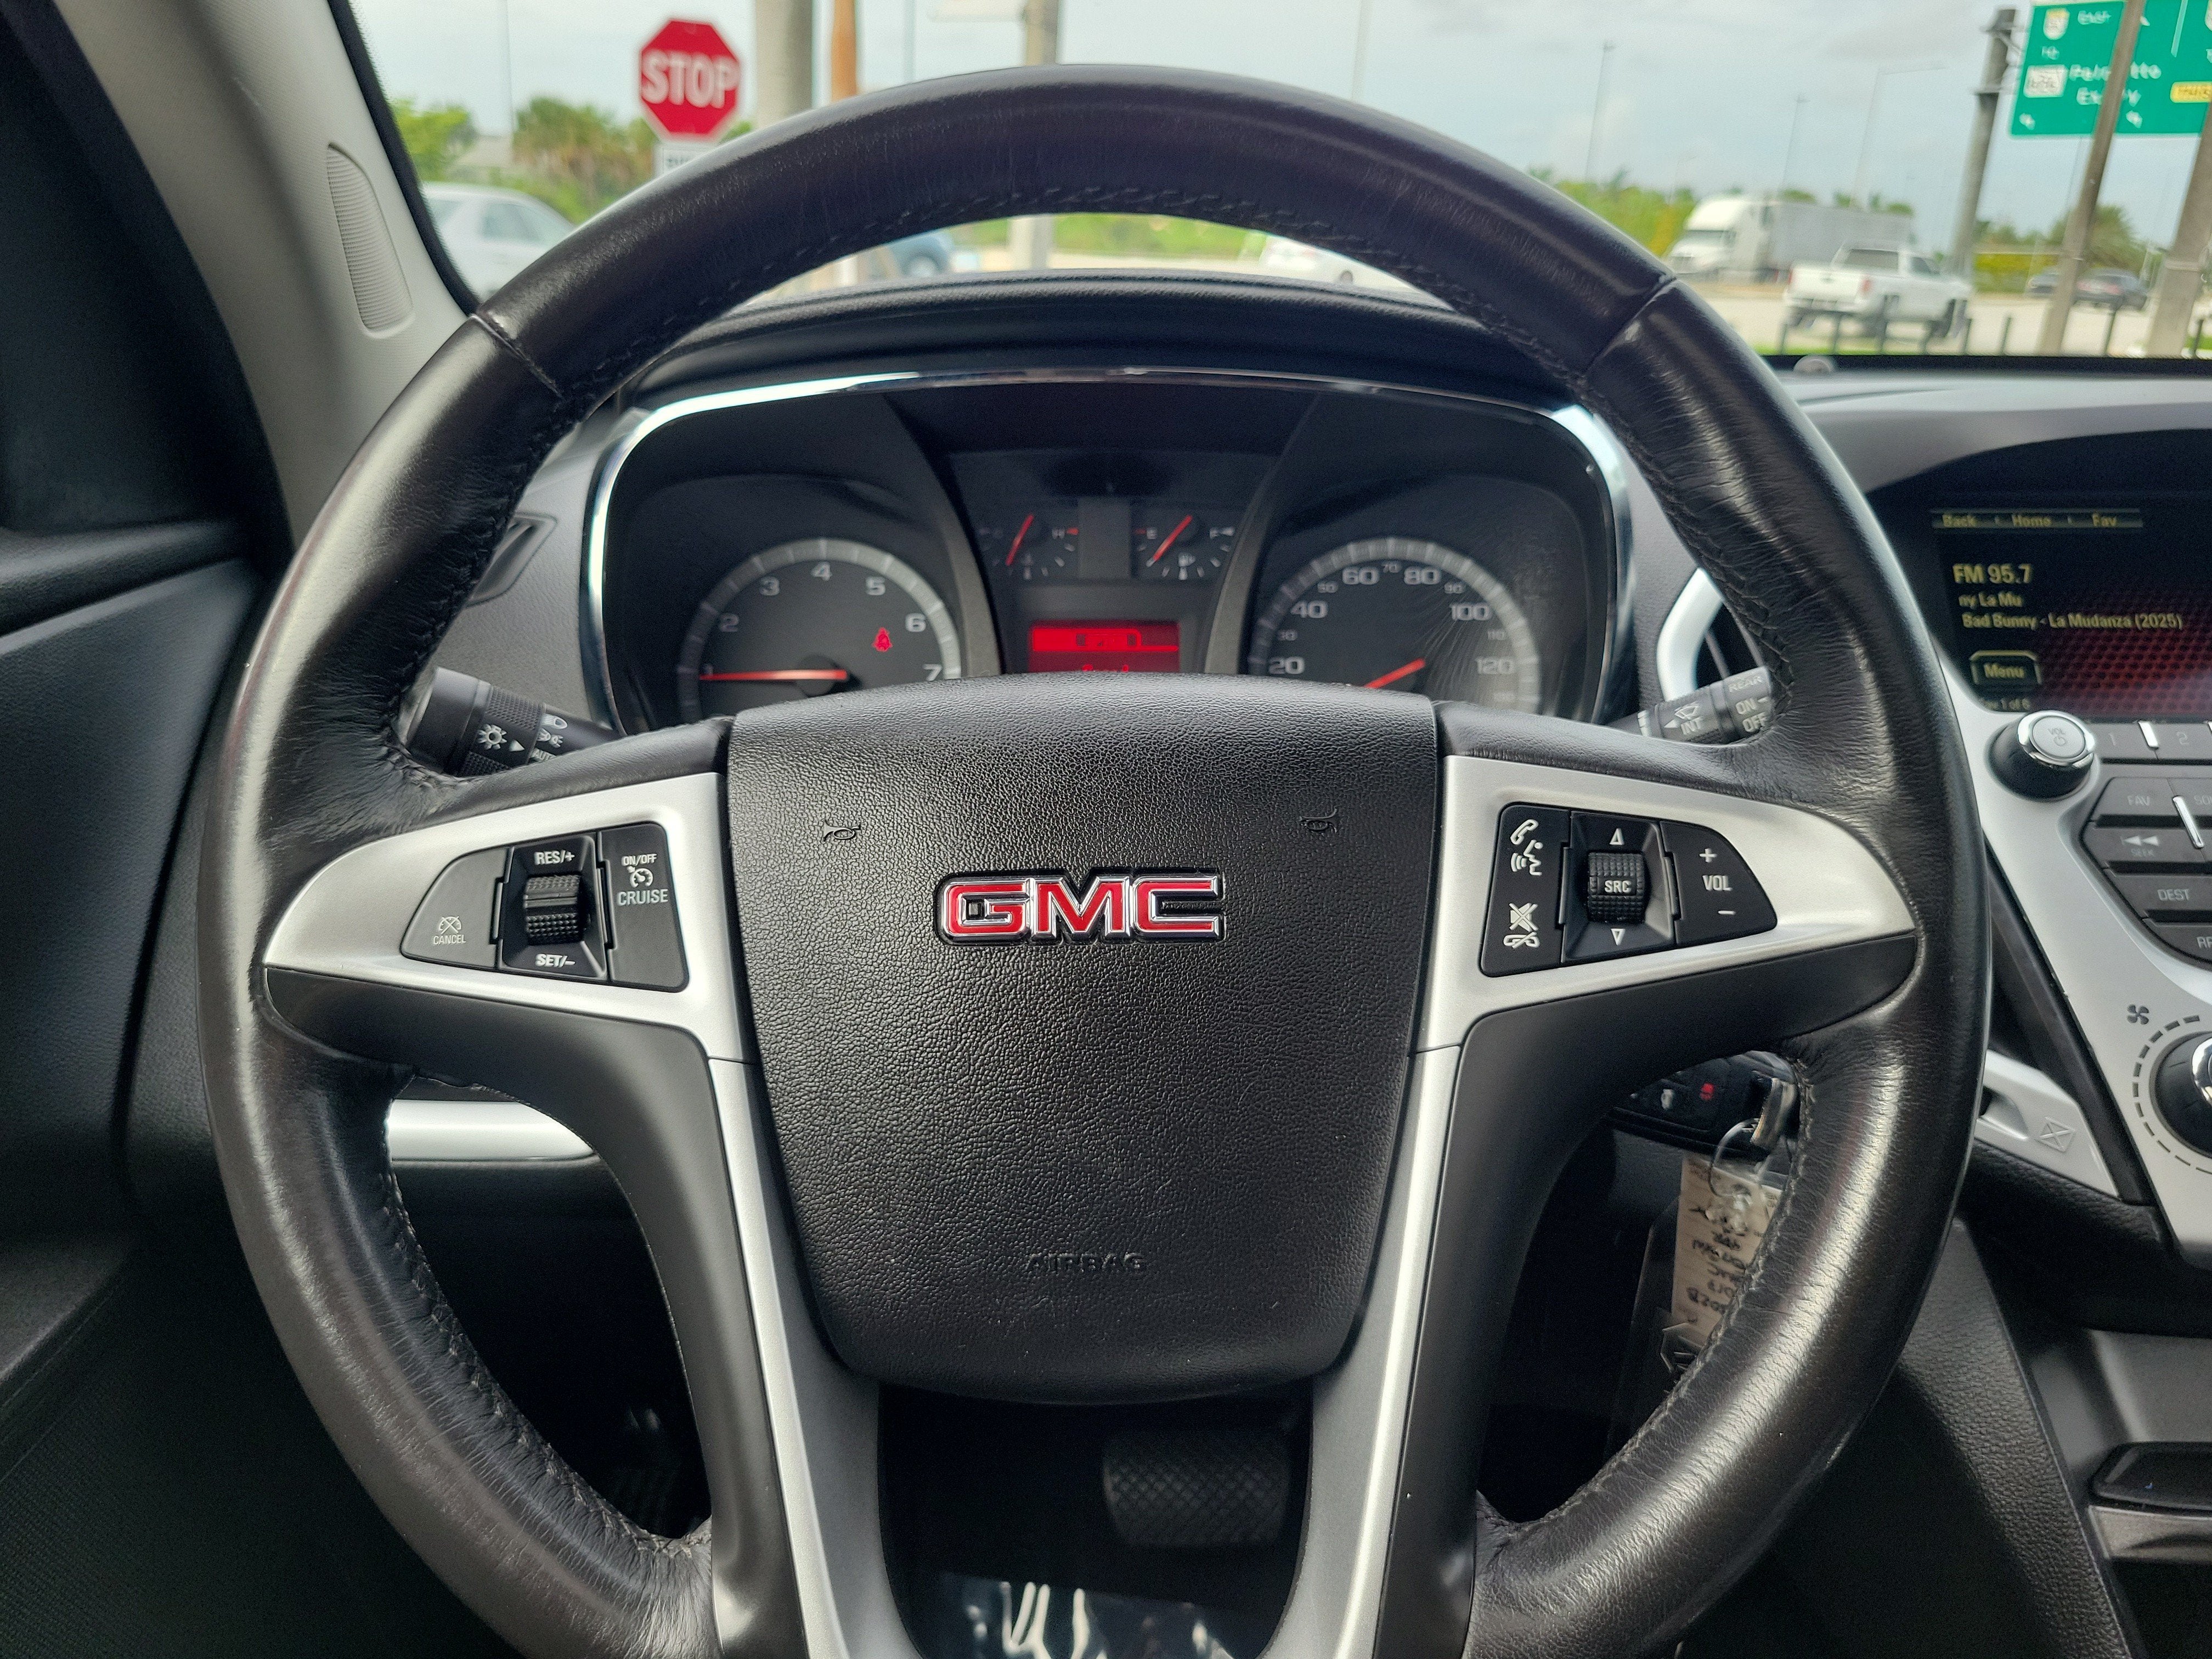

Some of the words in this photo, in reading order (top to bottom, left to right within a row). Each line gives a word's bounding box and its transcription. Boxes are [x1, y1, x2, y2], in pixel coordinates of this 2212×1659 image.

[641, 50, 740, 109] STOP
[1943, 513, 1976, 527] Back
[2012, 514, 2052, 527] Home
[2092, 512, 2117, 527] Fav
[812, 562, 832, 581] 4
[1342, 567, 1379, 585] 60
[1403, 567, 1442, 585] 80
[1953, 563, 1984, 584] FM
[1988, 564, 2031, 584] 95.7
[760, 577, 780, 596] 3
[866, 577, 886, 596] 5
[1978, 591, 1997, 607] La
[1997, 591, 2022, 607] Mu
[1291, 600, 1328, 619] 40
[1449, 603, 1492, 622] 100
[719, 614, 739, 632] 2
[905, 614, 926, 632] 6
[1962, 612, 1991, 628] Bad
[1992, 612, 2037, 630] Bunny
[2048, 612, 2068, 628] La
[2068, 612, 2131, 628] Mudanza
[2135, 613, 2183, 630] (2025)
[923, 664, 942, 681] 7
[1269, 657, 1305, 675] 20
[1476, 658, 1515, 674] 120
[1984, 663, 2024, 678] Menu
[1735, 698, 1756, 714] ON
[1681, 716, 1701, 735] INT
[2047, 727, 2066, 736] VOL
[2128, 795, 2151, 806] FAV
[534, 851, 575, 865] RES/+
[621, 854, 657, 866] ON/OFF
[1604, 879, 1632, 893] SRC
[1702, 875, 1733, 891] VOL
[617, 889, 669, 906] CRUISE
[2157, 888, 2190, 901] DEST
[943, 876, 1219, 937] GMC
[433, 934, 467, 945] CANCEL
[1025, 1252, 1146, 1271] AIRBAG
